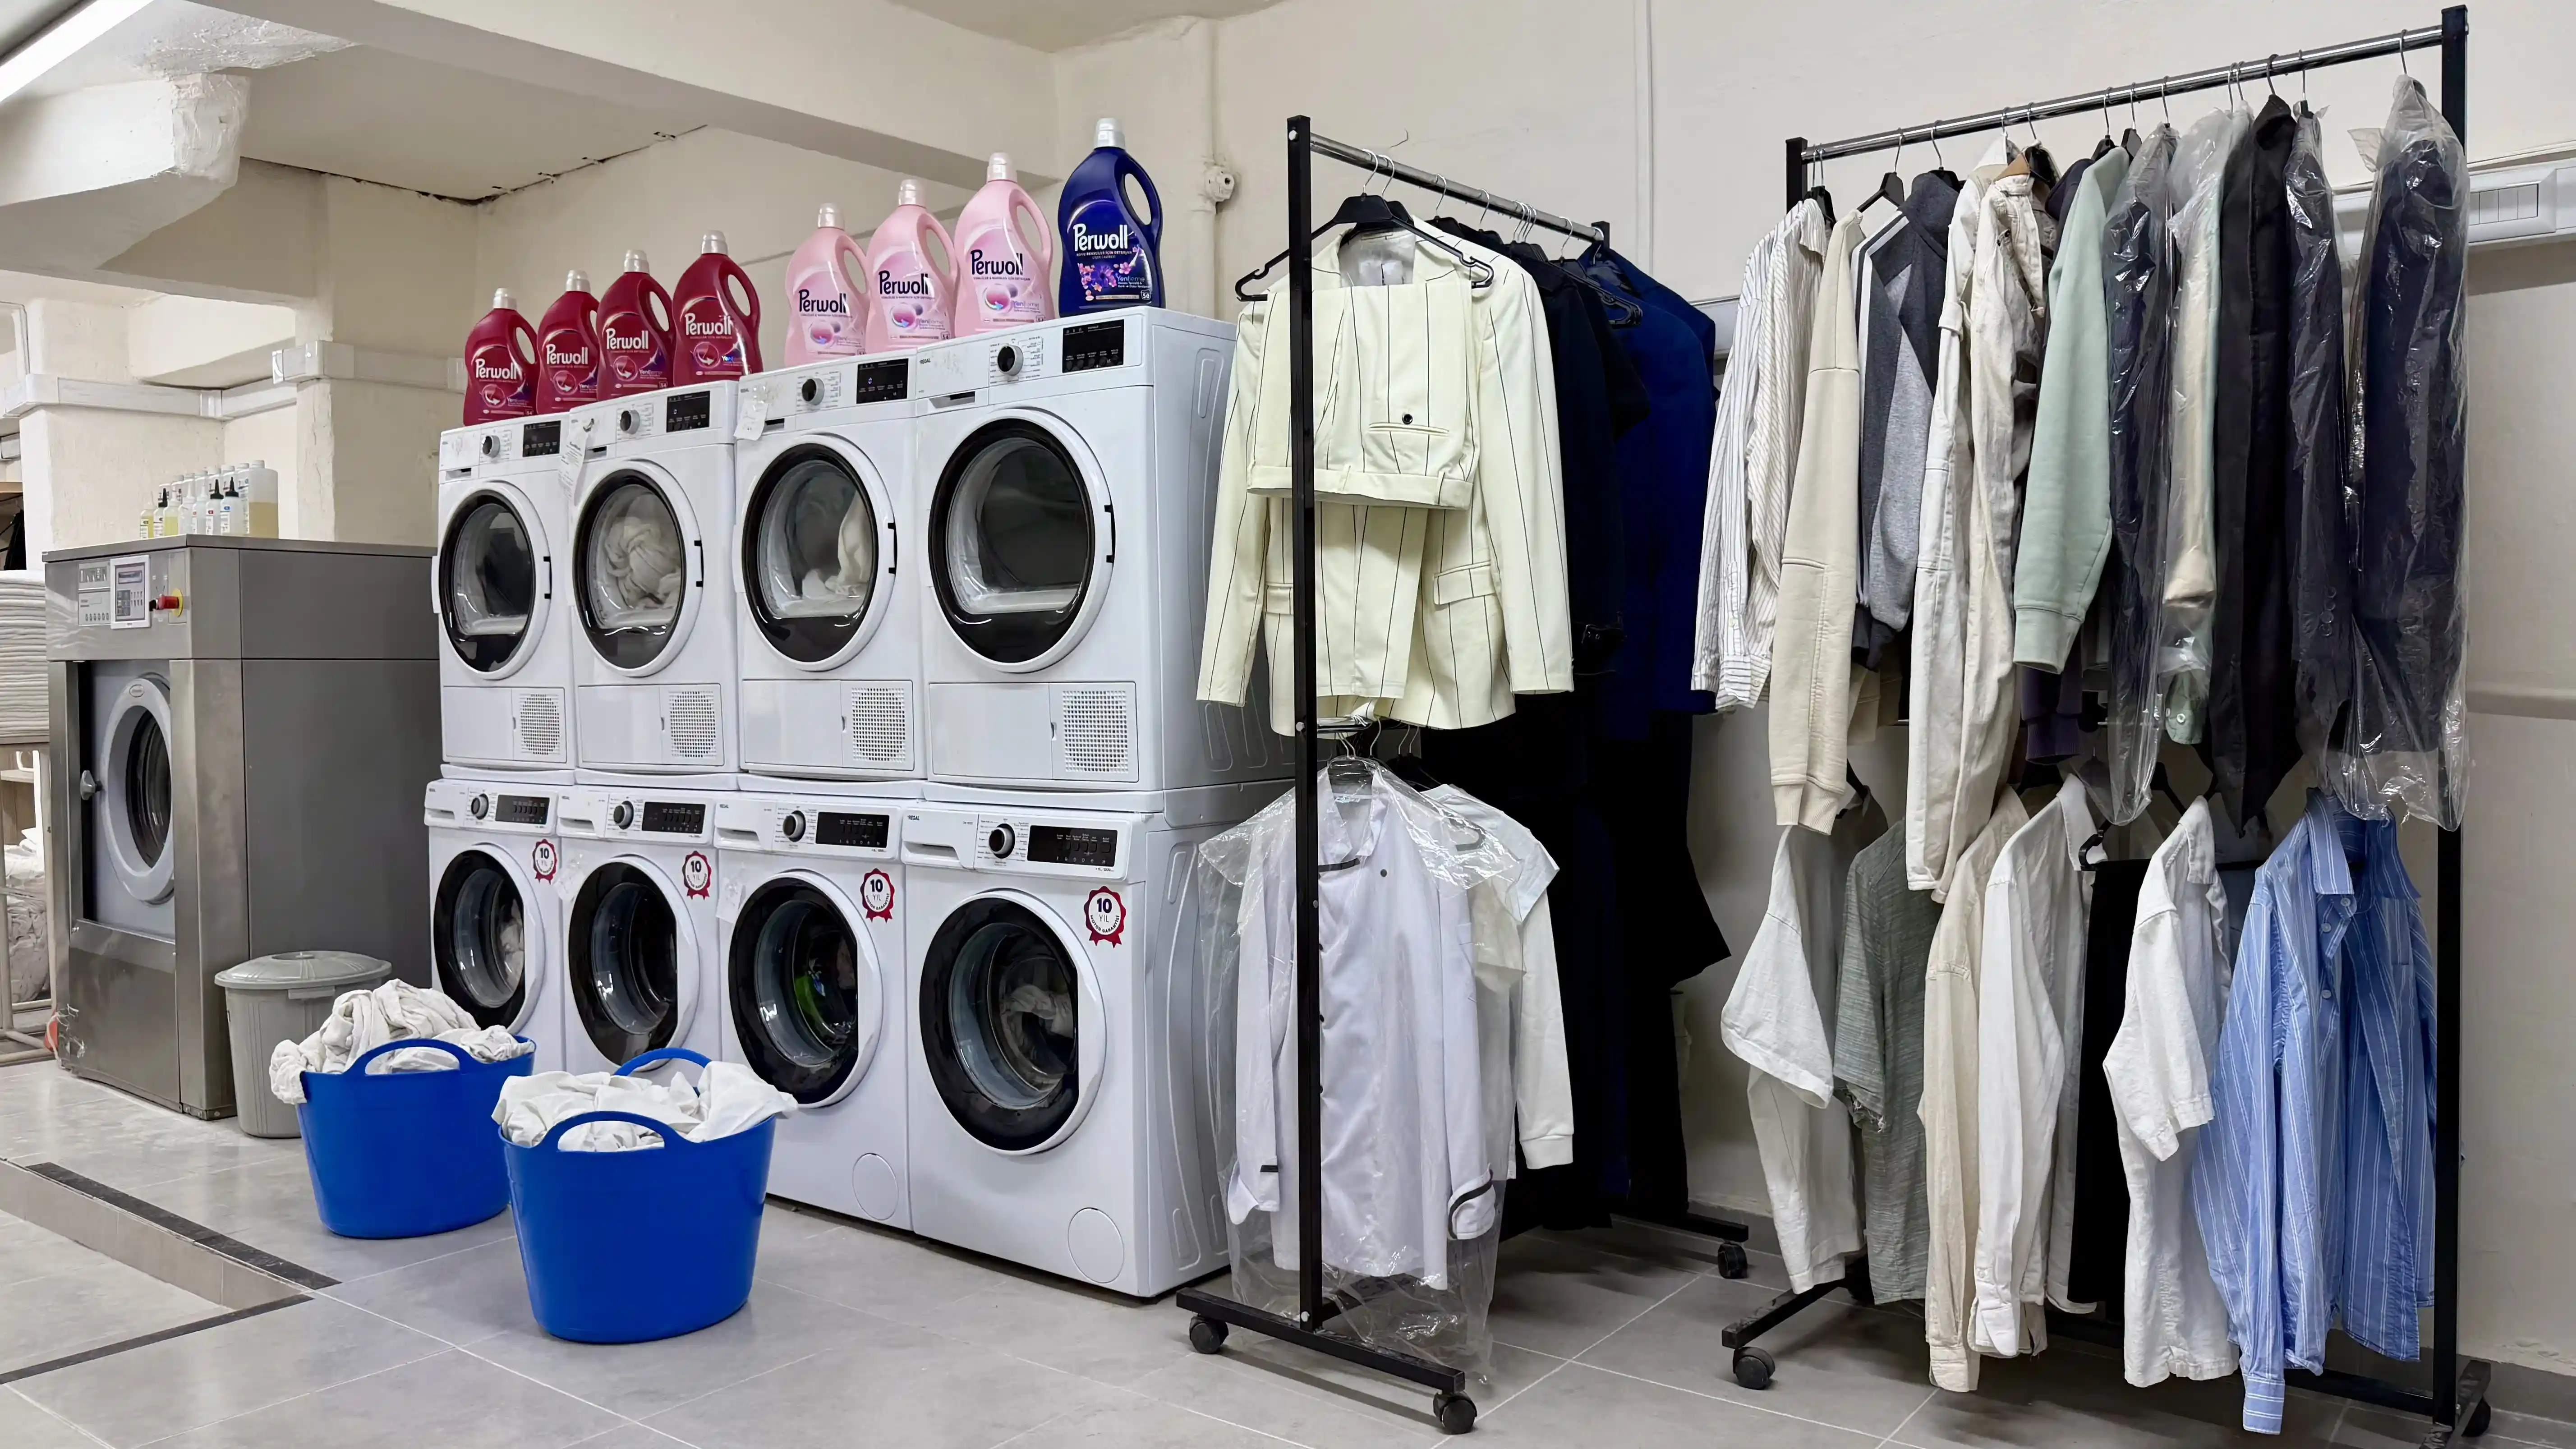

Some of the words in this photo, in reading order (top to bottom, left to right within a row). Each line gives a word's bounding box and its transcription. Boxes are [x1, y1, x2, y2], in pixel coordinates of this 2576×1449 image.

[1073, 223, 1128, 251] Perwoll
[971, 249, 1023, 276] Perwoll
[879, 270, 929, 294] Perwoll
[799, 289, 846, 313] Perwoll
[685, 313, 731, 335] Perwoll
[606, 328, 649, 350] Perwoll
[546, 343, 588, 364] Perwoll
[475, 358, 517, 380] Perwoll
[540, 847, 549, 859] 10
[690, 860, 702, 873] 10
[870, 879, 883, 892] 10
[1096, 897, 1112, 913] 10
[1090, 915, 1101, 931] MOTOR
[1099, 914, 1109, 923] YIL
